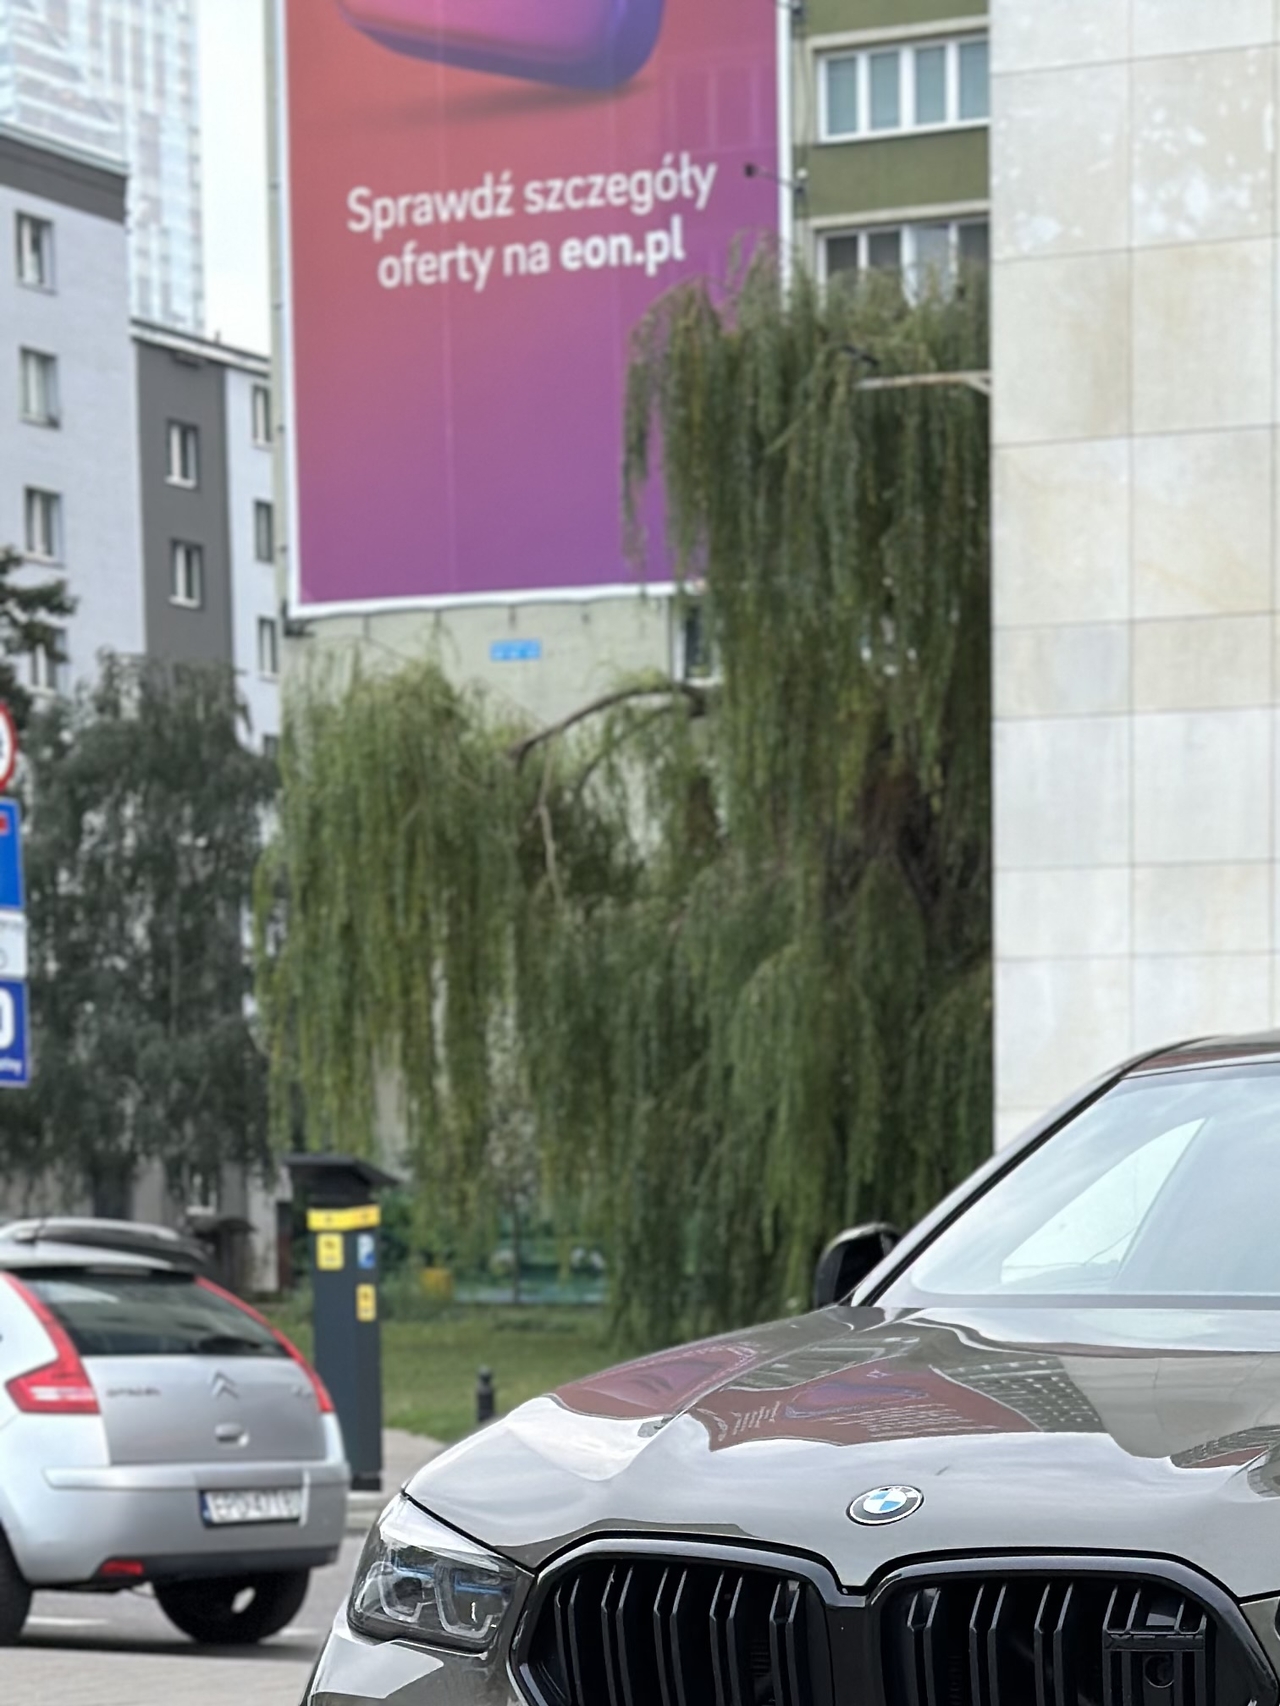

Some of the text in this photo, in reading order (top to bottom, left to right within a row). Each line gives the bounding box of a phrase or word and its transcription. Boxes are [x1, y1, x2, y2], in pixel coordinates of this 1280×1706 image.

[346, 151, 717, 242] Sprawdź szczegóły
[377, 214, 686, 293] oferty na eon.pl
